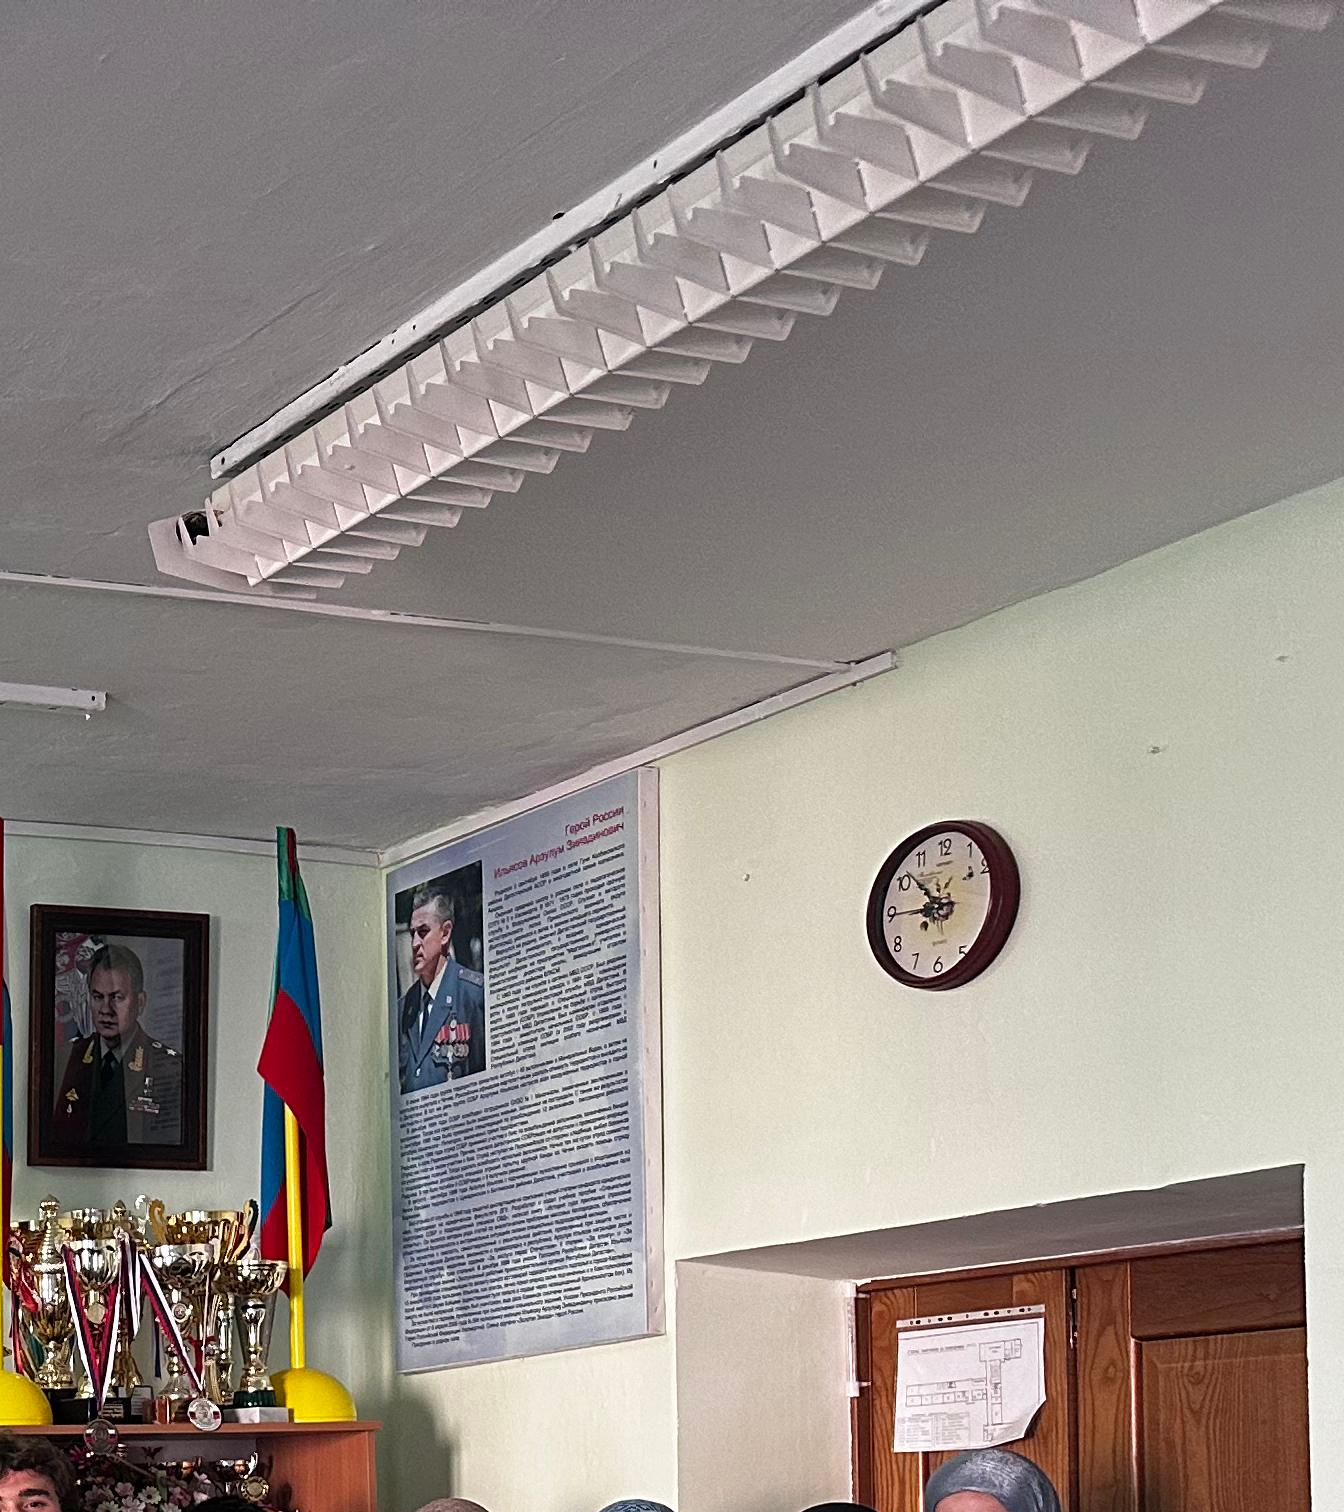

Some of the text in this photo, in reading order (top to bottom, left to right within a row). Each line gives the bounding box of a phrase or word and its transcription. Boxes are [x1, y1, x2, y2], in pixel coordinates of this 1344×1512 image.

[938, 838, 952, 856] 12
[967, 842, 973, 858] 1
[916, 851, 926, 868] 11
[897, 874, 911, 892] 10
[887, 906, 897, 923] 9
[894, 935, 902, 952] 8
[912, 953, 920, 970] 7
[933, 956, 943, 973] 6
